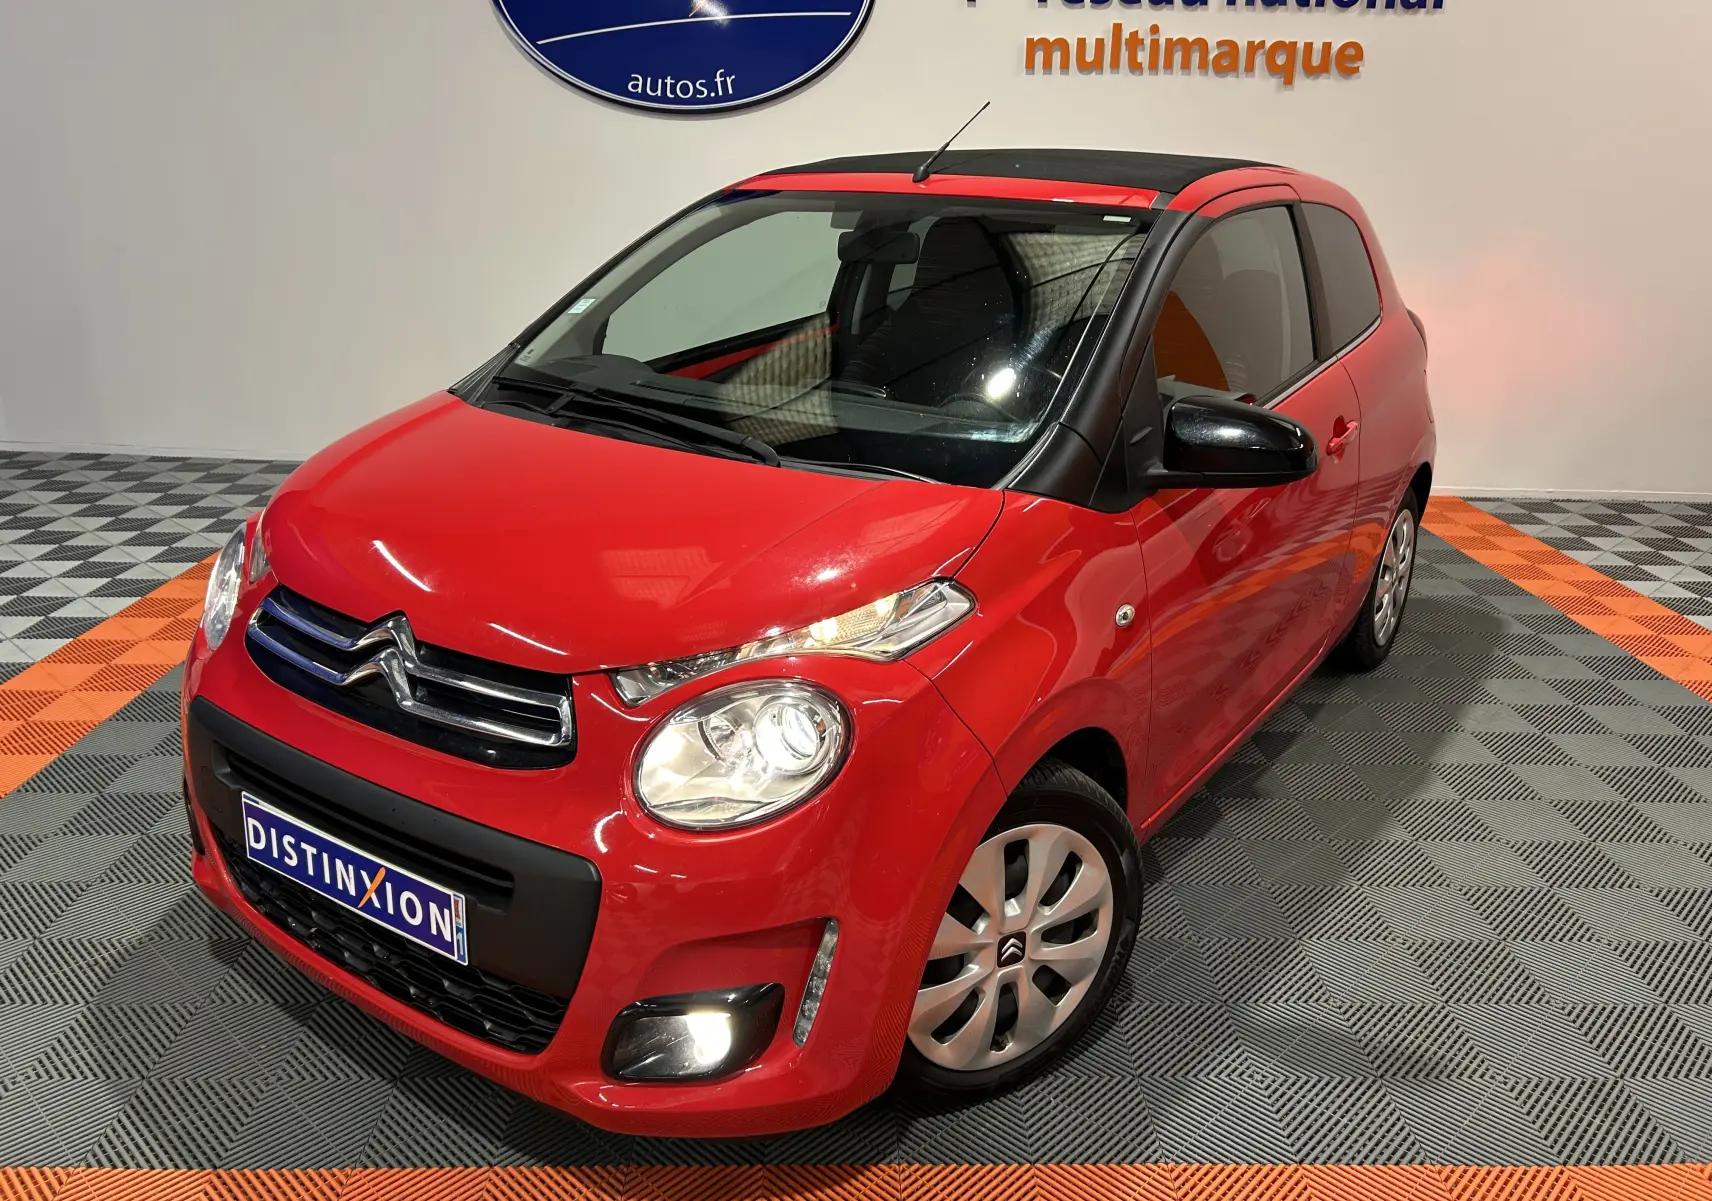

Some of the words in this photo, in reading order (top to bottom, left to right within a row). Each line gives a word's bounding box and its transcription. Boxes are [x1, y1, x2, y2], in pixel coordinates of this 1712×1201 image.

[627, 69, 736, 99] autos.fr
[1025, 22, 1364, 86] multimarque
[247, 816, 452, 942] DISTINXION
